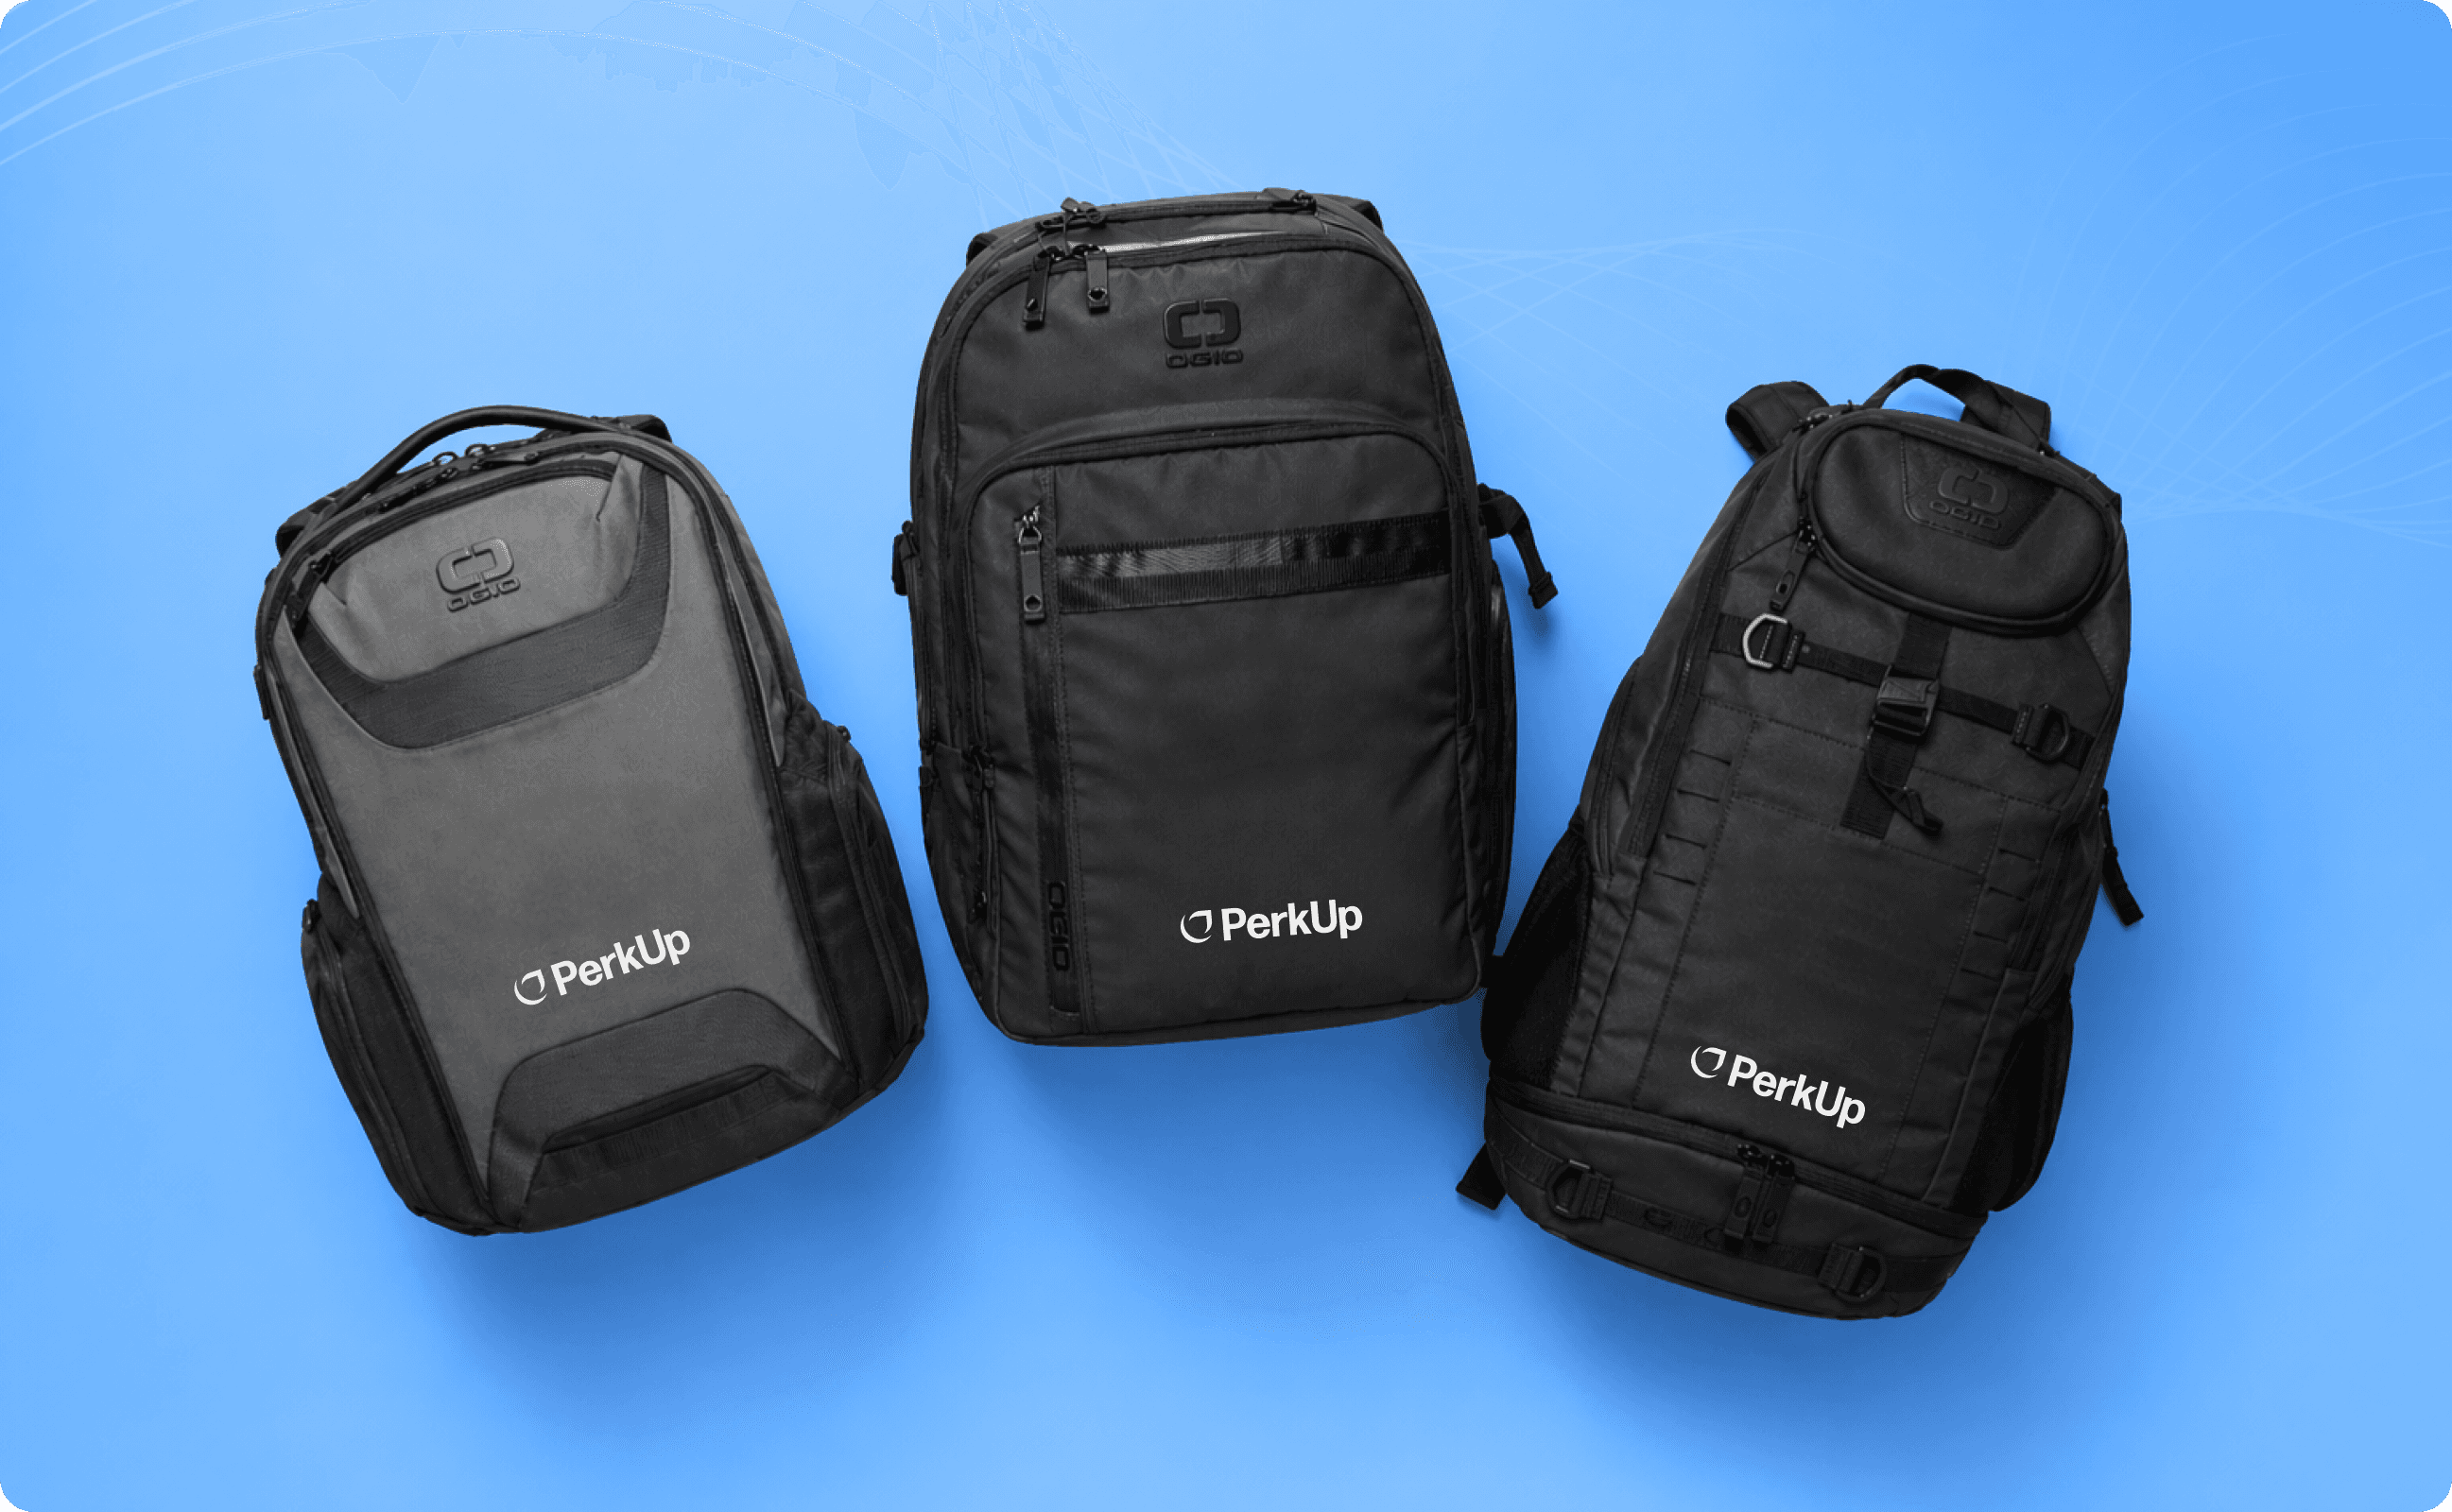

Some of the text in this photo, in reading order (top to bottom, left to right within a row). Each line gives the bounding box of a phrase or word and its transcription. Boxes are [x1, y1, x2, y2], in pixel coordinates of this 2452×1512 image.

[1166, 349, 1244, 369] OGIO
[447, 577, 521, 612] OGIO
[1049, 882, 1069, 972] OGIO
[1221, 900, 1362, 940] PerkUp
[550, 929, 690, 996] PerkUp
[1728, 1055, 1865, 1128] PerkUp
